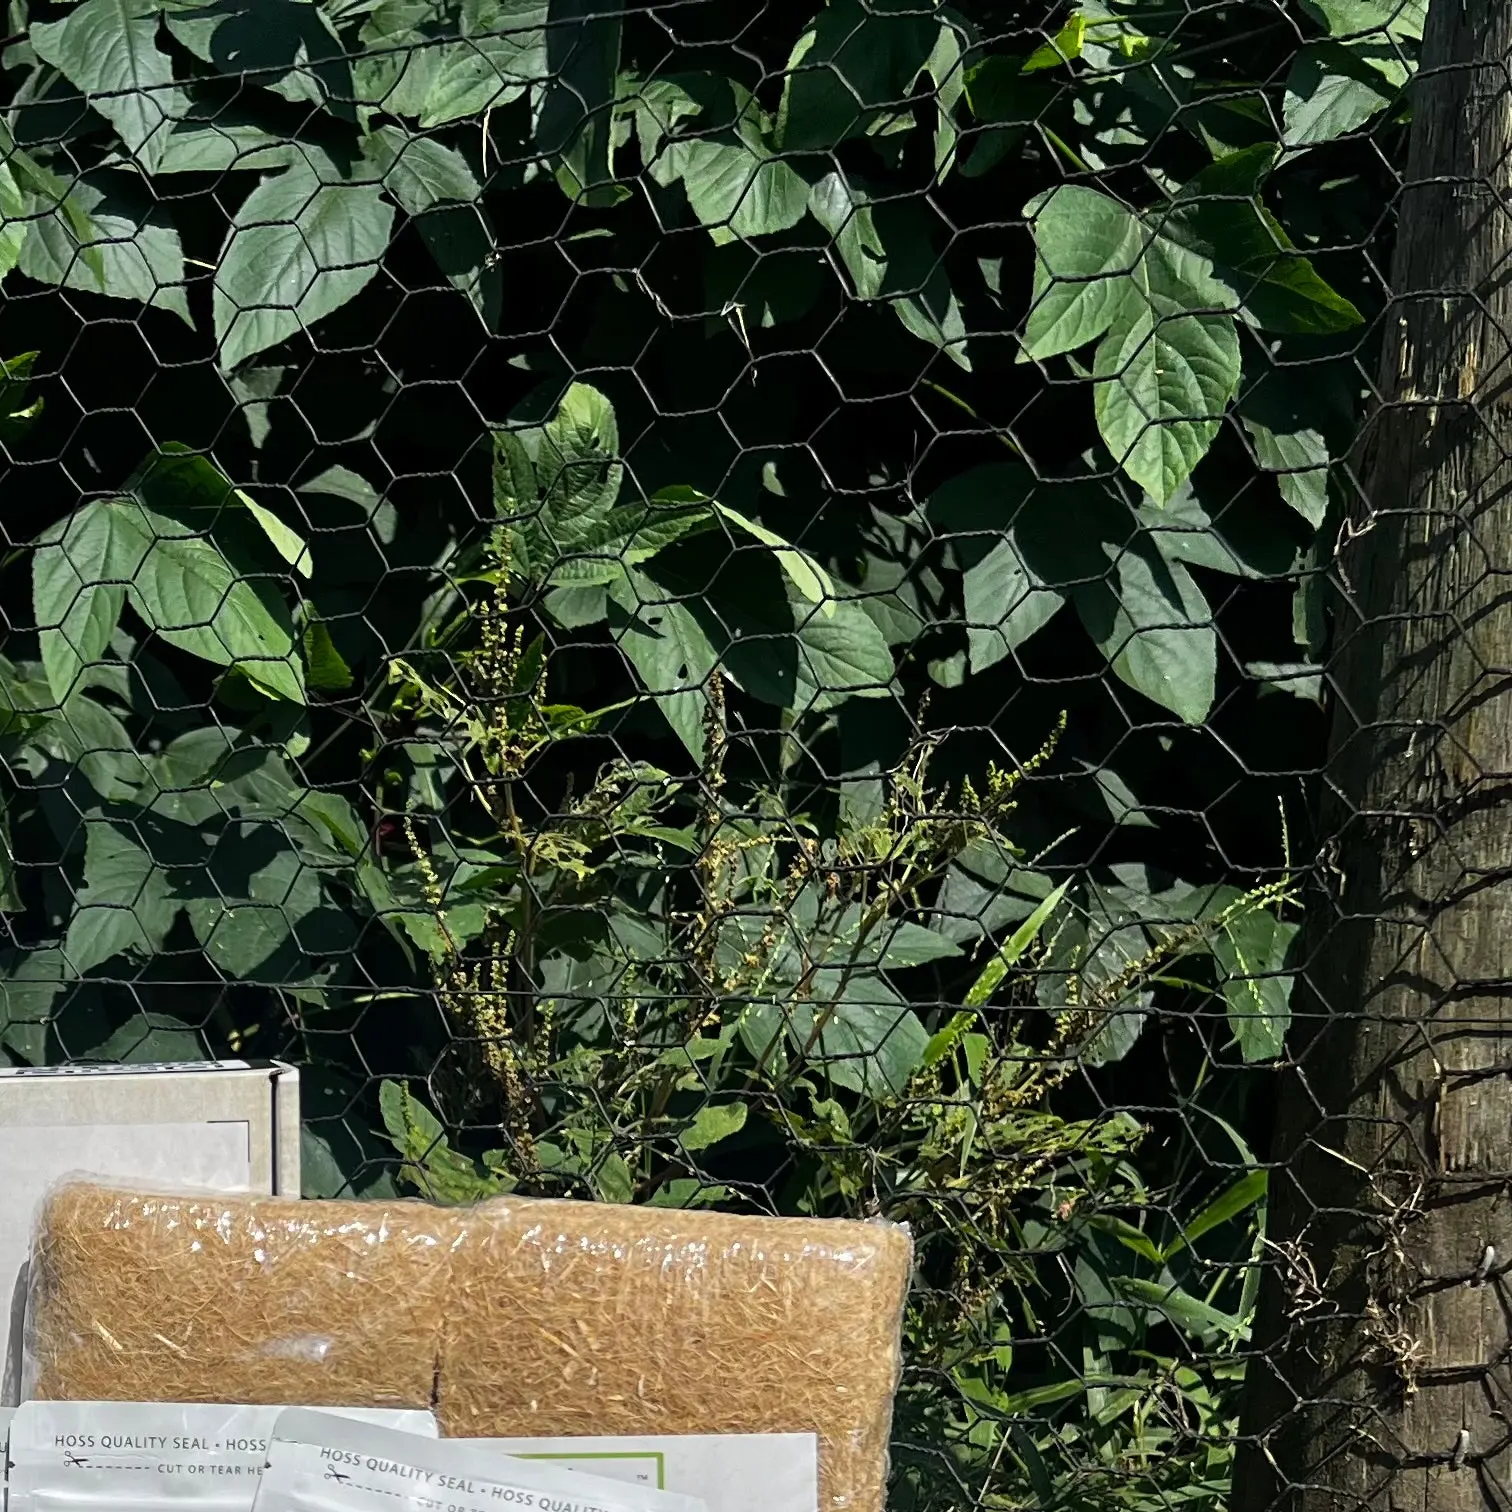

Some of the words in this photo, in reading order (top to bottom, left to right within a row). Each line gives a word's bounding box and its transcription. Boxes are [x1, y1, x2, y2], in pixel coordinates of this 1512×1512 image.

[55, 1434, 95, 1447] HOSS
[100, 1435, 167, 1451] QUALITY
[172, 1437, 209, 1450] SEAL
[226, 1438, 266, 1451] HOSS
[158, 1464, 184, 1473] CUT
[188, 1465, 205, 1475] OR
[209, 1465, 241, 1475] TEAR
[320, 1448, 361, 1465] HOSS
[367, 1459, 433, 1482] QUALITY
[438, 1475, 474, 1493] SEAL
[491, 1487, 534, 1506] HOSS
